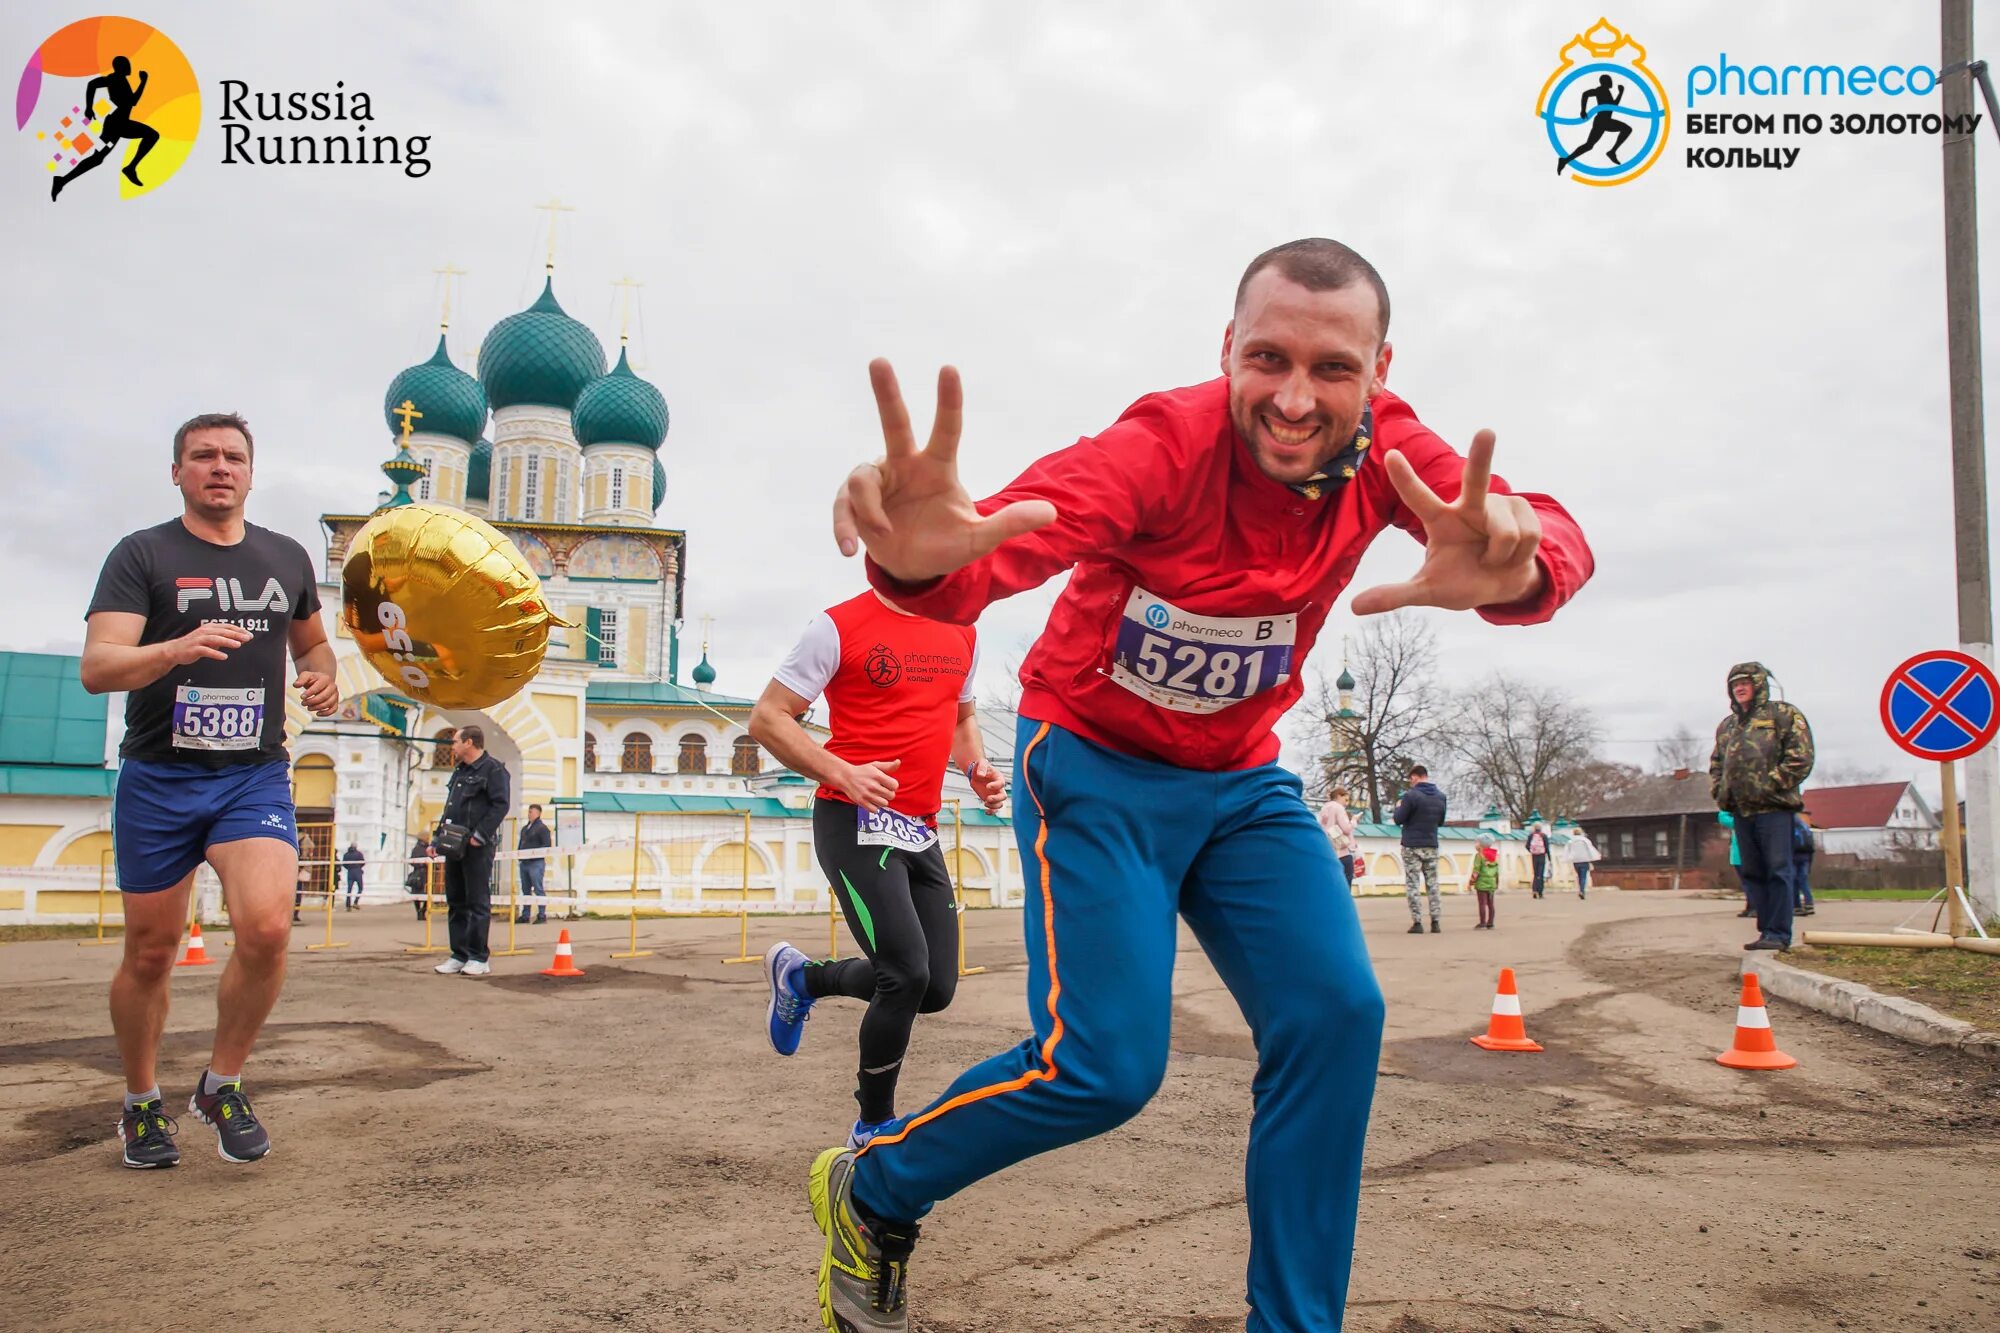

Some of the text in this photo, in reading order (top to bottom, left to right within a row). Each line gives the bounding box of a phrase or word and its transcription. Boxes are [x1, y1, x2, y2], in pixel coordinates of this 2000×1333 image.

[175, 577, 290, 614] FILA
[1172, 620, 1273, 640] pharmeco B
[904, 652, 961, 665] pharmeco
[1136, 633, 1264, 697] 5281
[246, 690, 255, 701] C
[183, 706, 255, 737] 5388
[868, 812, 925, 844] 5285
